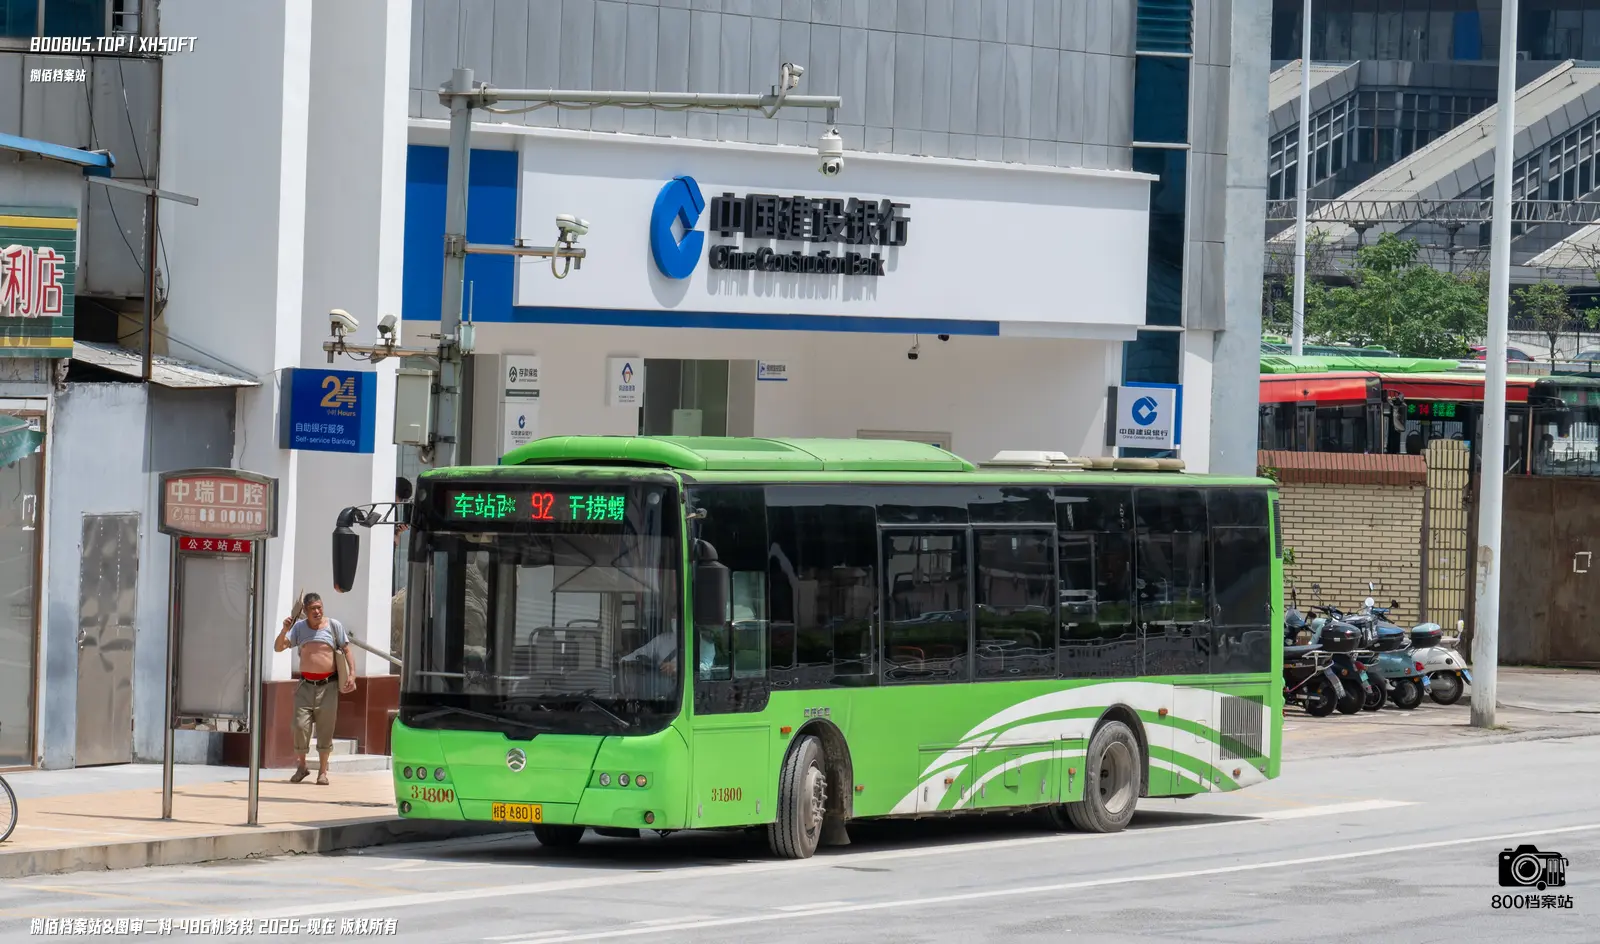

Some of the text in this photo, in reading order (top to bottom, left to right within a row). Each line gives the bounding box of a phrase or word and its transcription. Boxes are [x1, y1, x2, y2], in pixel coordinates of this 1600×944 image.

[710, 192, 911, 247] 中国建设银行
[709, 245, 886, 276] China Construction Bank
[0, 244, 65, 318] 利店
[320, 376, 356, 408] 24
[296, 422, 344, 434] 自助银行服务
[332, 437, 356, 446] Banking
[1119, 428, 1168, 436] 中国建设银行
[171, 479, 264, 506] 中瑞口腔
[531, 492, 554, 520] 92
[188, 538, 242, 552] 公交站点
